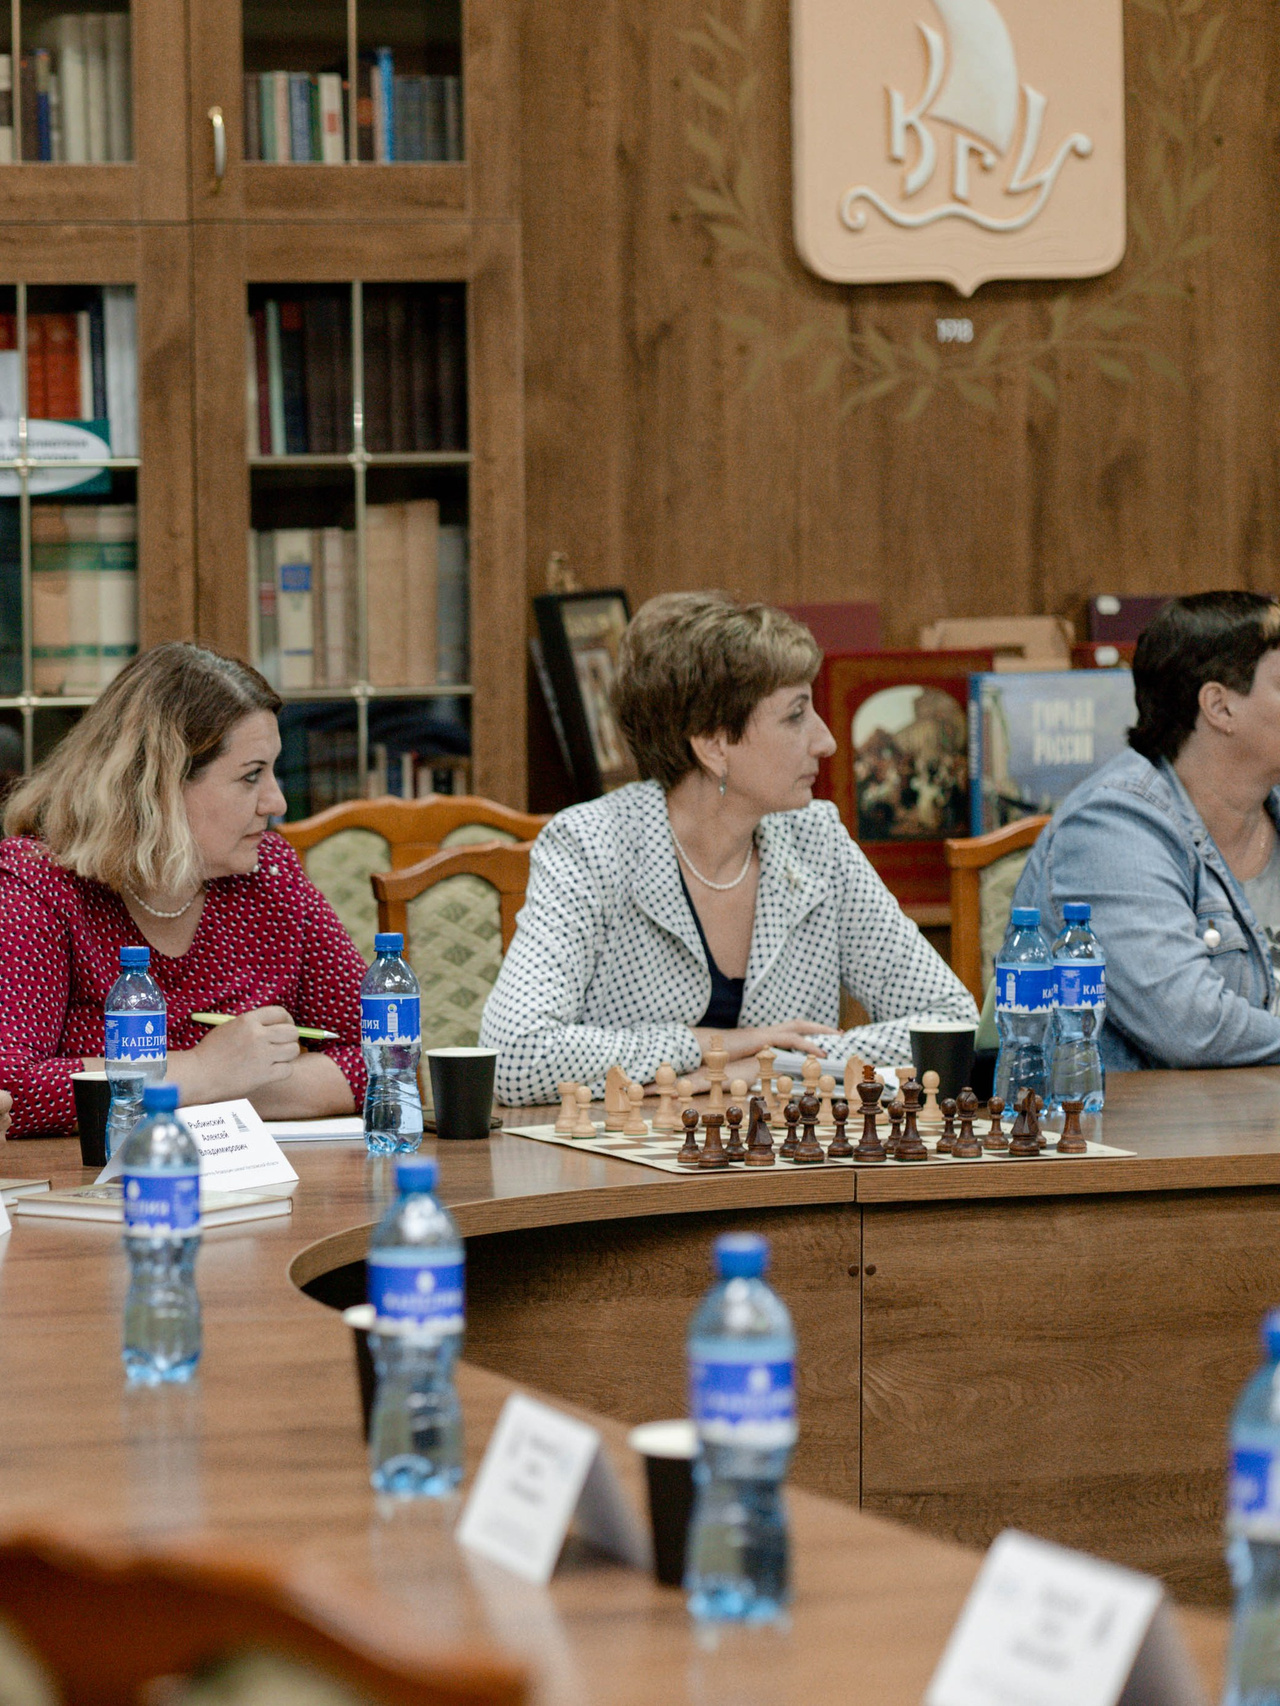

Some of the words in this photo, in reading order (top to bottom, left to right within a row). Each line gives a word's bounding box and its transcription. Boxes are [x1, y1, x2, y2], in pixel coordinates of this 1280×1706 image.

[187, 1116, 226, 1130] Рыбинский
[201, 1130, 230, 1142] Алексей
[197, 1142, 249, 1157] Владимирович
